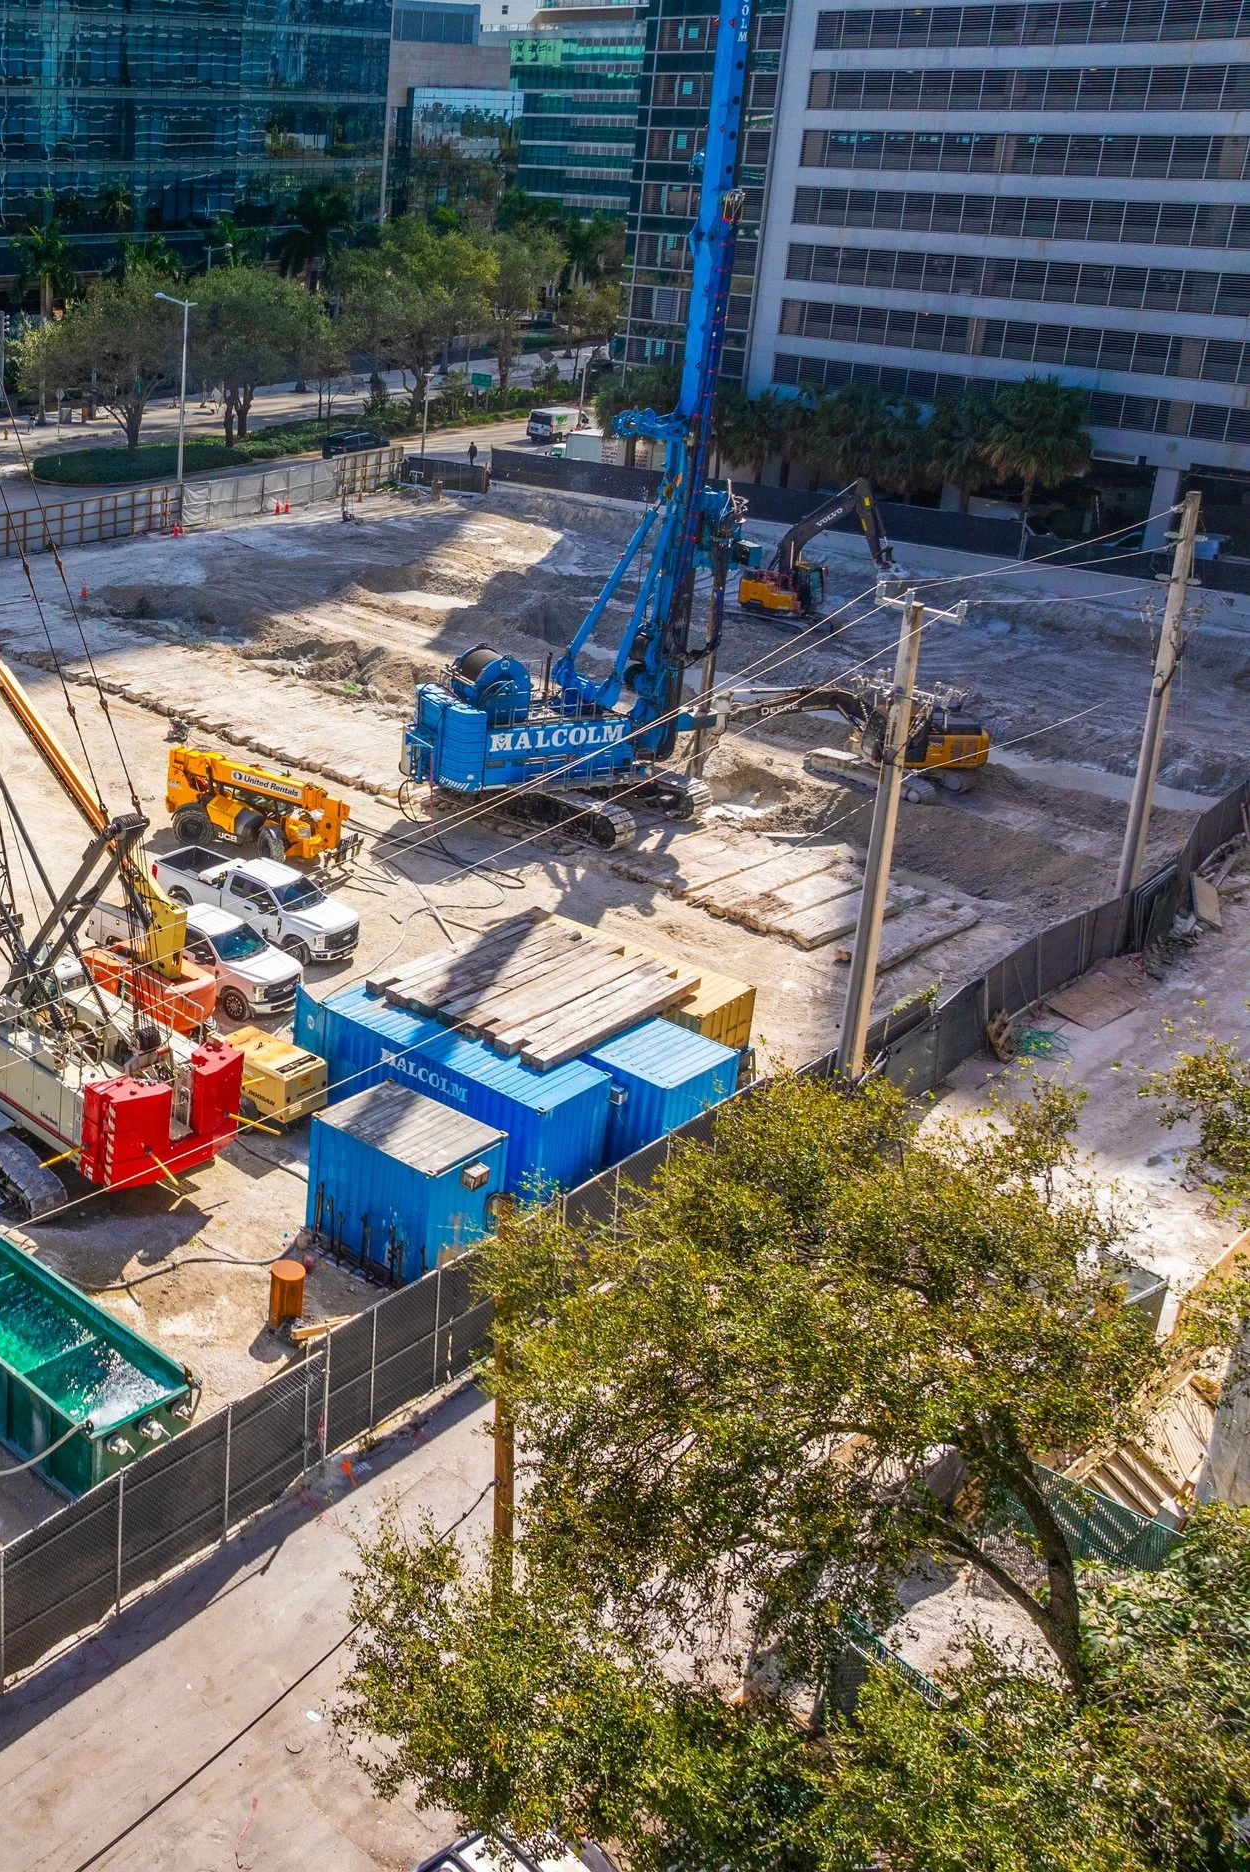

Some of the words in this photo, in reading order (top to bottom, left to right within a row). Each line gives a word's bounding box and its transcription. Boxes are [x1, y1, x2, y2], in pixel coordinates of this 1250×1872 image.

[815, 507, 843, 527] VOLVO
[489, 724, 625, 752] MALCOLM
[243, 774, 270, 788] United
[270, 782, 299, 797] Rentals
[217, 831, 238, 843] JCB
[380, 1047, 469, 1103] MALCOLM
[248, 1089, 276, 1107] DOOSAN
